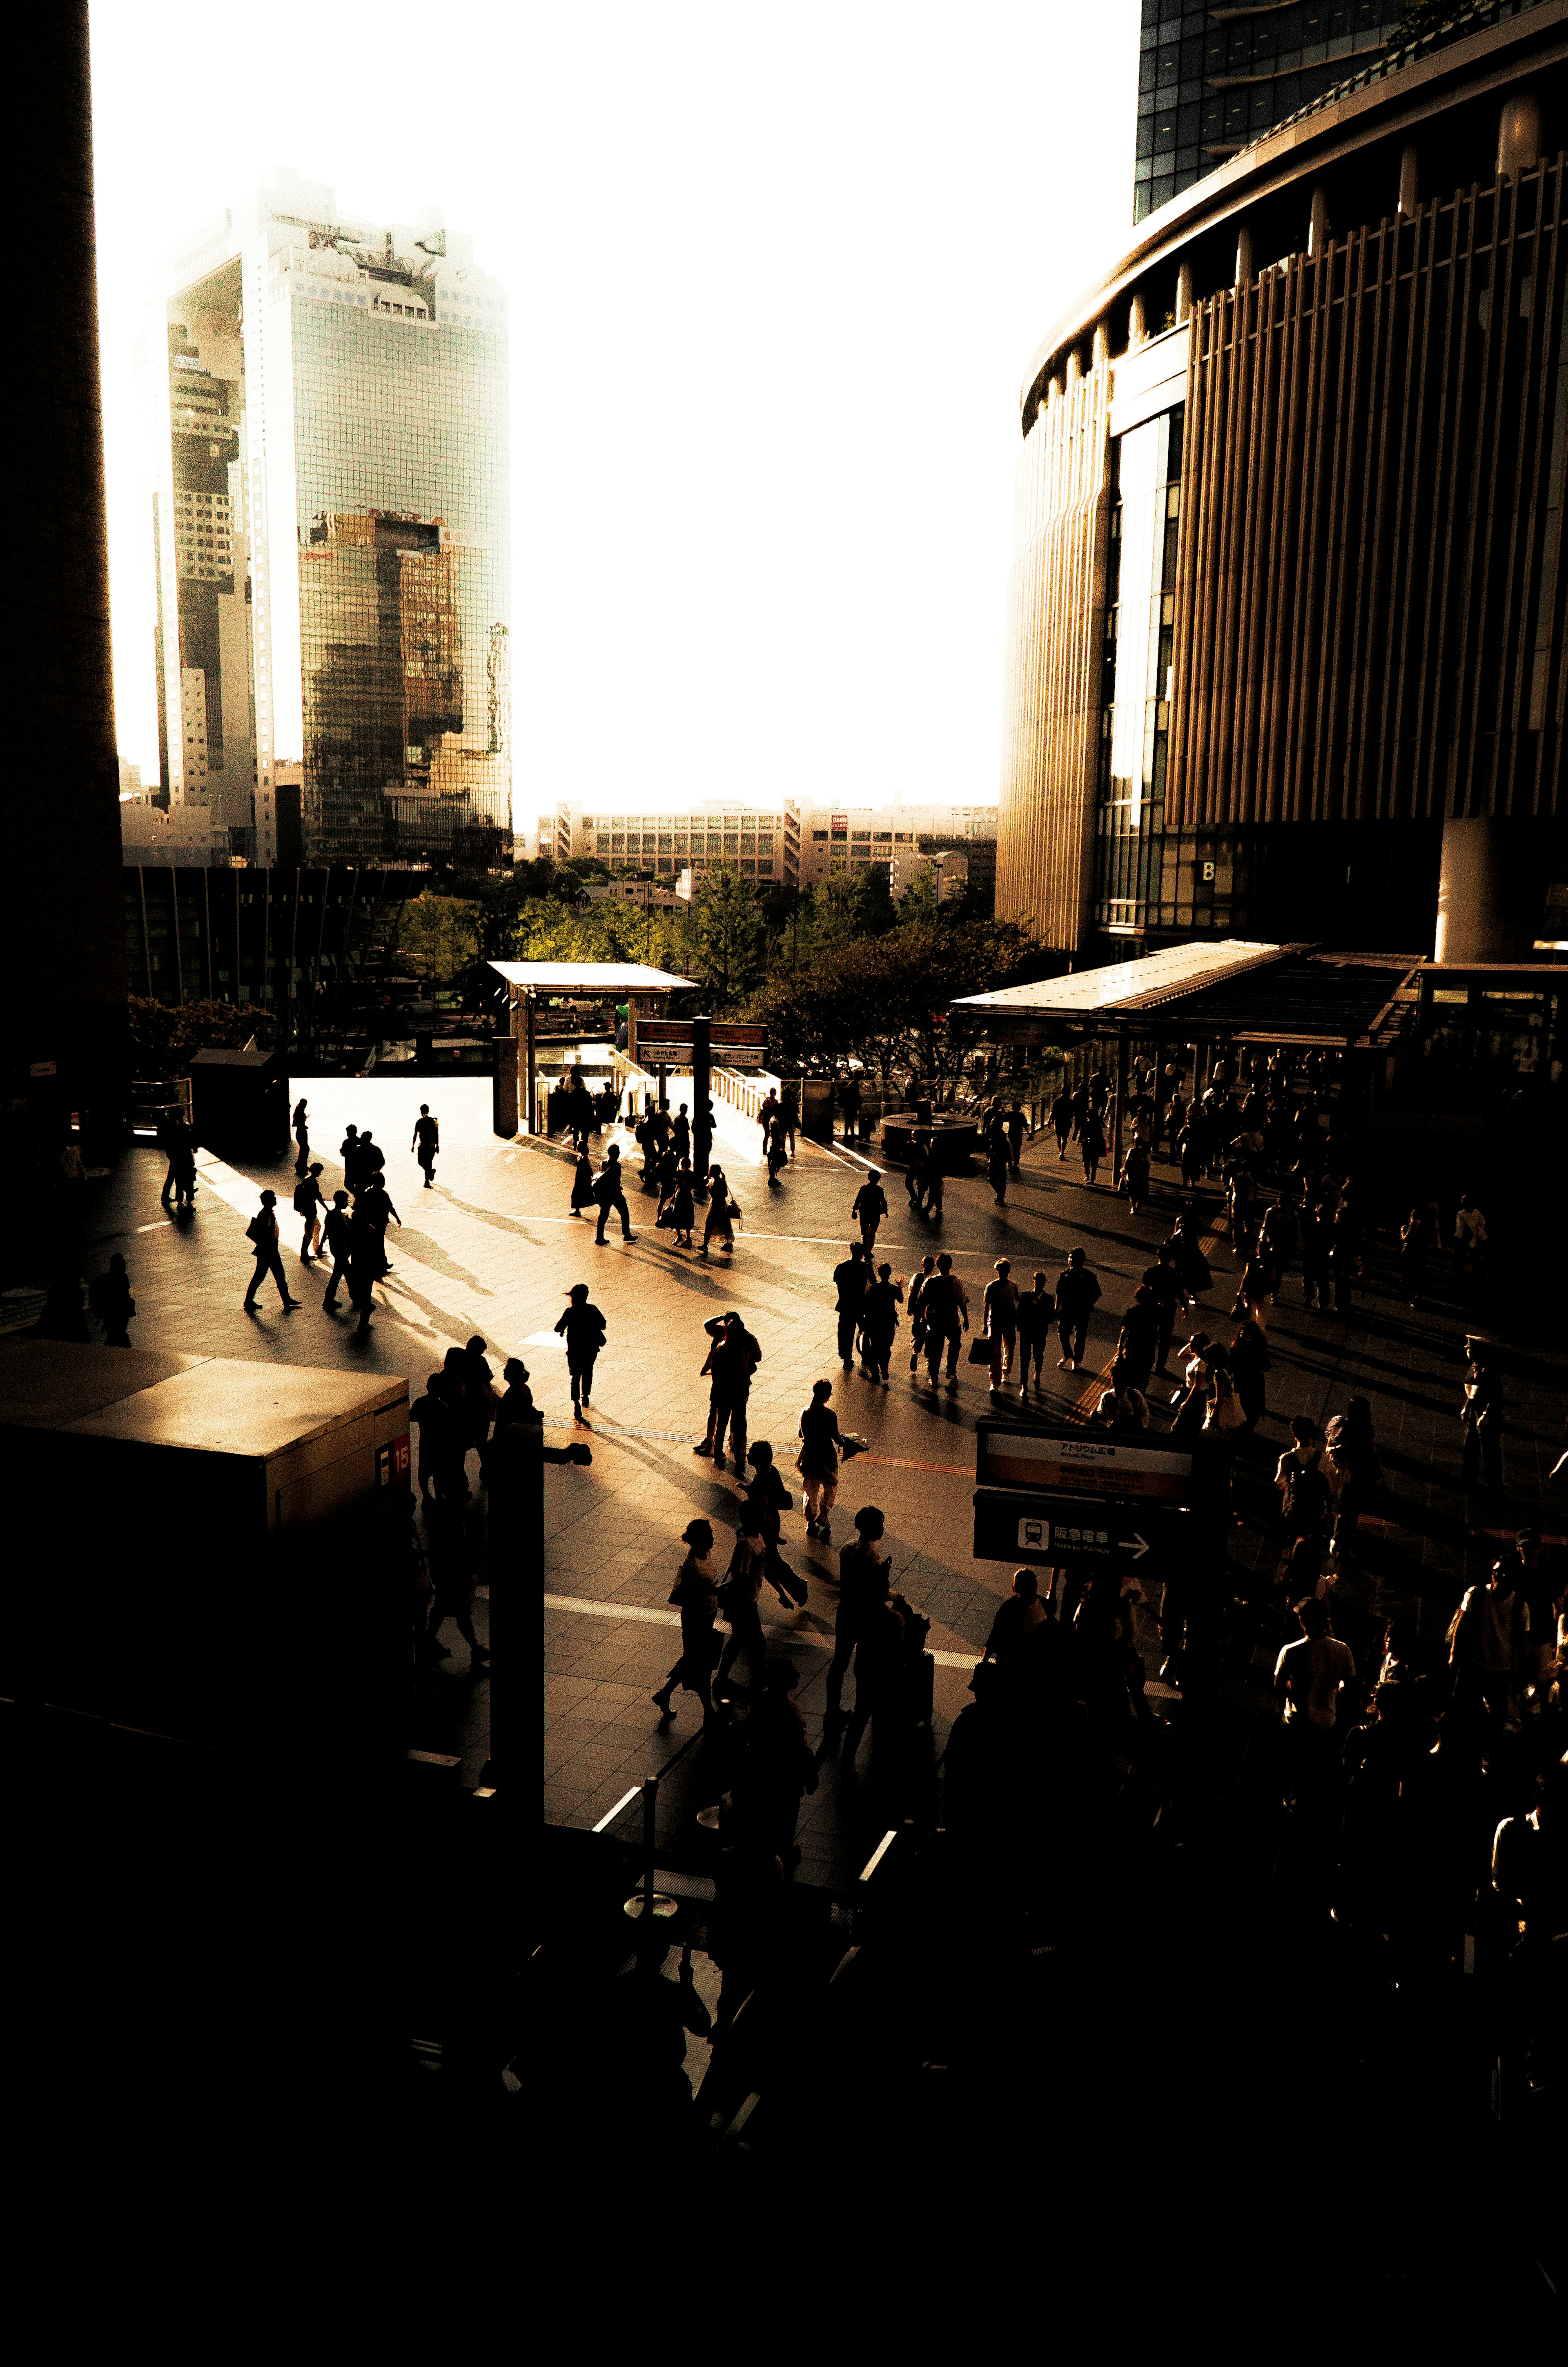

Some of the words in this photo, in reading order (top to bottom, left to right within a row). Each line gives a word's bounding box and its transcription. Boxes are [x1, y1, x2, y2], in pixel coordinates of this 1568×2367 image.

[1203, 861, 1215, 880] B
[395, 1445, 409, 1471] 15
[1055, 1526, 1108, 1544] 阪急電車
[1054, 1541, 1080, 1551] Hankyu
[1083, 1544, 1110, 1554] Railway
